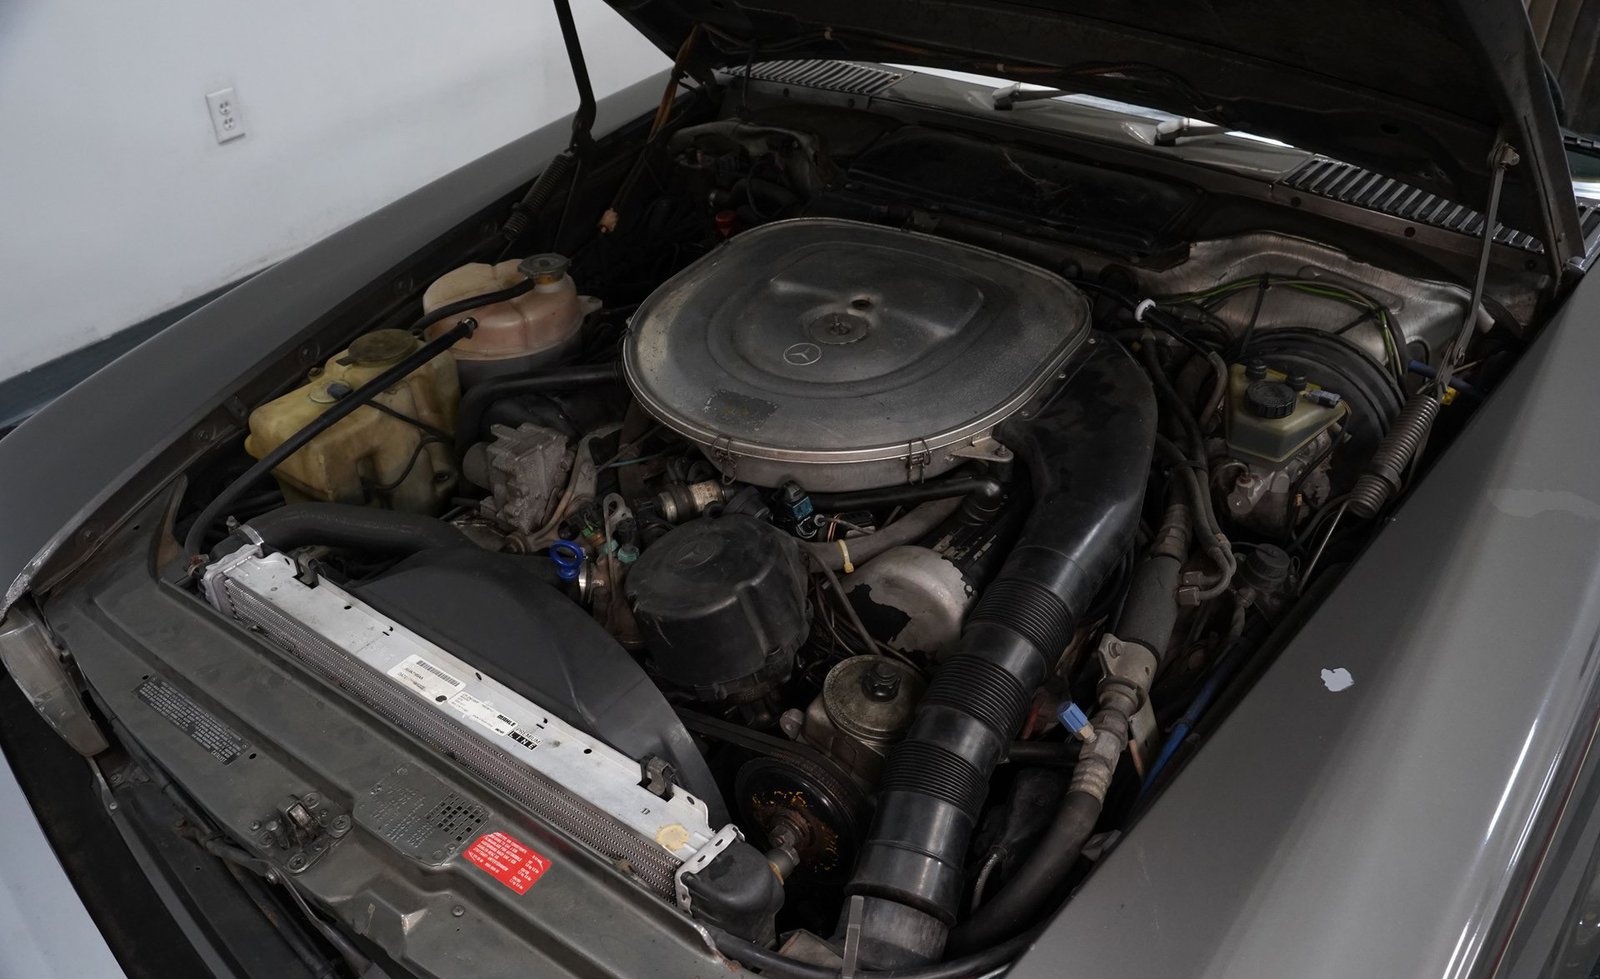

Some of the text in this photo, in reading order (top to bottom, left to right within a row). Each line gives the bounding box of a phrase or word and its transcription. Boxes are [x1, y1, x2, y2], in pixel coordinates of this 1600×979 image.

[497, 714, 516, 727] MAHLE
[509, 731, 536, 749] LINE
[516, 727, 541, 743] PREMIUM
